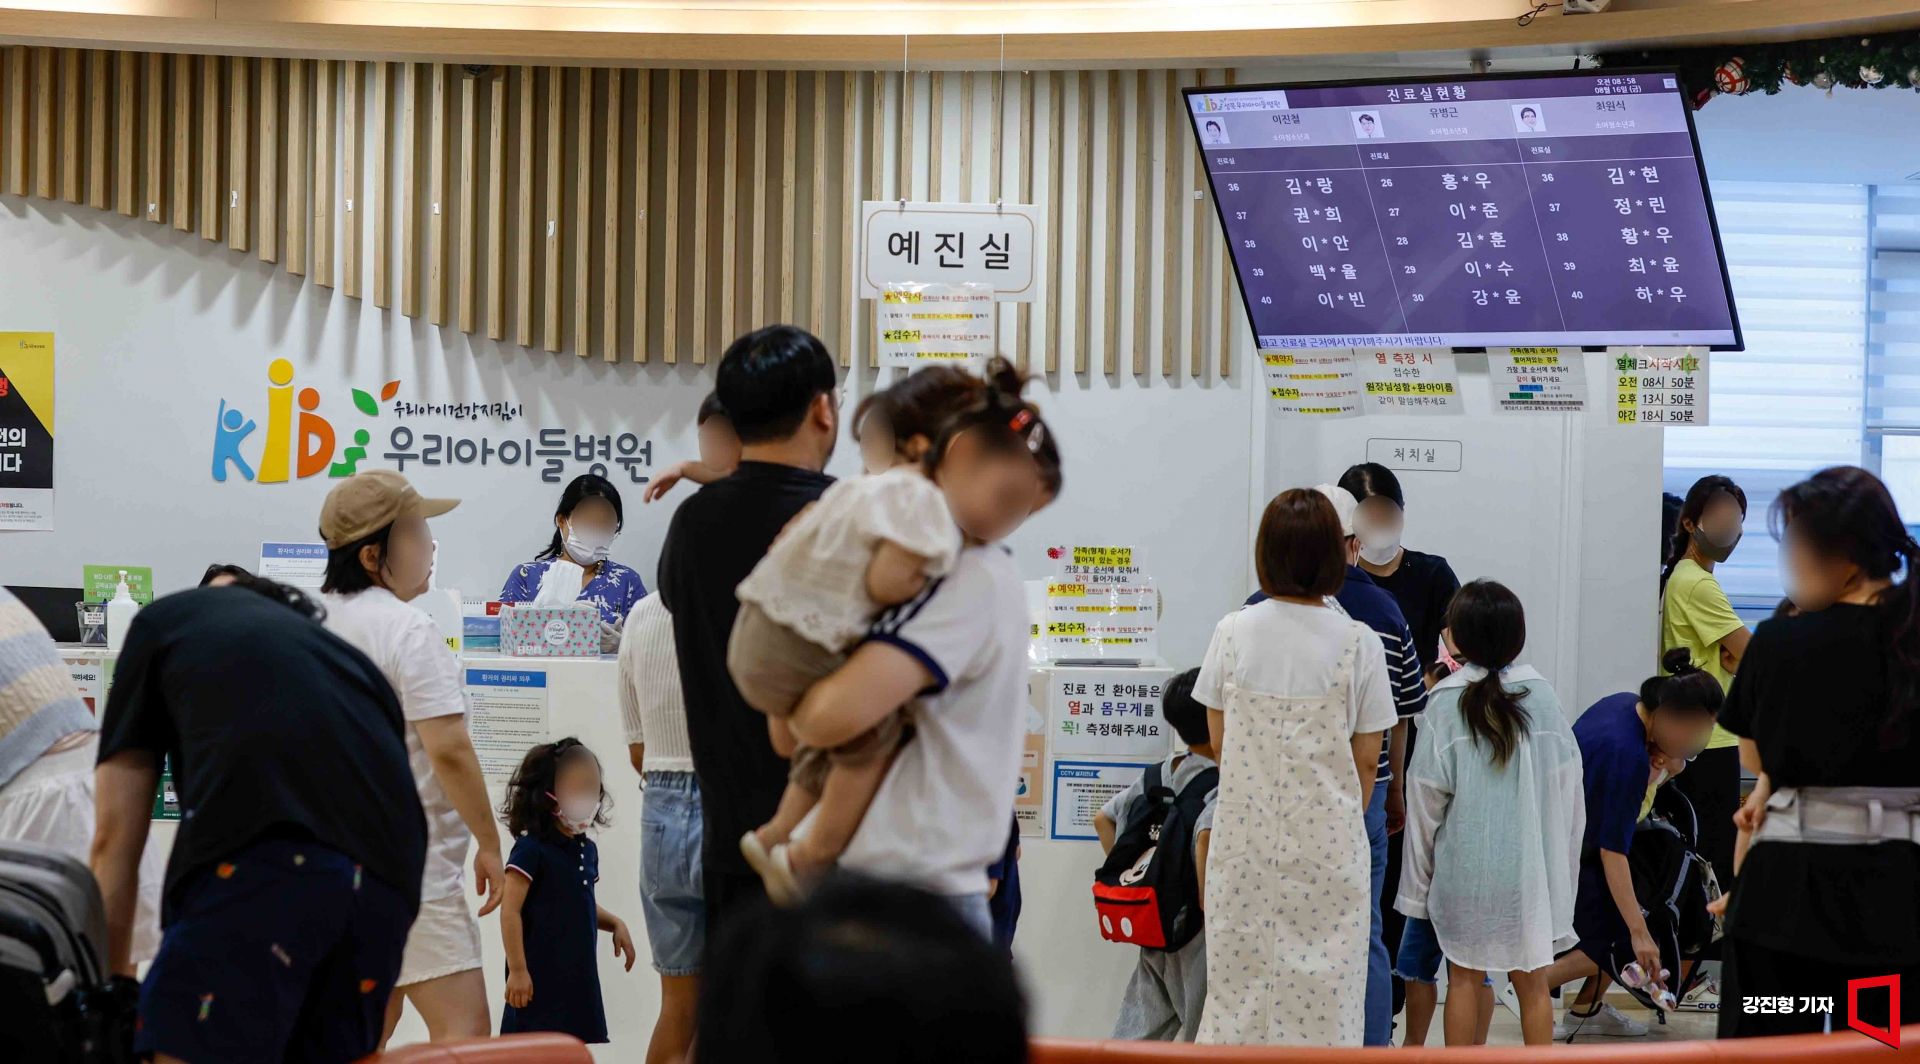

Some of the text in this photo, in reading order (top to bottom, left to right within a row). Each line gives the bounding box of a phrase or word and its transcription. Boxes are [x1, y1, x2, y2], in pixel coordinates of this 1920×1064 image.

[1597, 78, 1611, 86] 오전
[1594, 84, 1642, 94] 08월 16일 (금)
[1386, 86, 1467, 103] 진료실현황
[1596, 100, 1626, 111] 최원식
[1429, 107, 1459, 118] 유병근
[1272, 113, 1301, 125] 이진철
[1541, 173, 1554, 182] 36
[1227, 183, 1240, 192] 36
[1380, 179, 1393, 187] 26
[1388, 208, 1400, 216] 27
[1548, 203, 1561, 212] 37
[1236, 211, 1247, 220] 37
[1396, 237, 1408, 246] 28
[1556, 233, 1569, 241] 38
[1244, 239, 1256, 248] 38
[888, 231, 1009, 269] 예진실
[1404, 265, 1416, 274] 29
[1563, 262, 1576, 270] 39
[1252, 268, 1264, 276] 39
[1260, 296, 1272, 304] 40
[1412, 294, 1424, 302] 30
[1571, 291, 1583, 299] 40
[893, 330, 921, 340] 접수자
[1280, 338, 1307, 347] 진료실
[1310, 337, 1346, 347] 근처에서
[1348, 336, 1403, 346] 대기해주시기
[1405, 335, 1446, 346] 바랍니다.
[1375, 352, 1433, 365] 열 측정 시
[1617, 358, 1698, 371] 열체크시작시간
[1393, 367, 1421, 378] 접수한
[1366, 382, 1453, 393] 원장님성함+환아이름
[1618, 377, 1694, 388] 오전 08시 50분
[1277, 388, 1299, 397] 접수자
[1378, 396, 1447, 406] 같이 말씀해주세요
[1618, 394, 1694, 405] 오후 13시 50분
[393, 400, 523, 421] 우리아이건강지킴이
[1618, 411, 1694, 422] 야간 18시 50분
[384, 426, 652, 483] 우리아이들병원
[1393, 447, 1435, 462] 처치실
[1073, 547, 1131, 555] 가족(형제) 순서가
[1117, 556, 1131, 564] 경우
[1065, 565, 1079, 573] 가장
[1093, 565, 1115, 574] 순서에
[1057, 584, 1086, 593] 예약자
[1057, 622, 1086, 632] 접수자
[1063, 683, 1161, 698] 진료 전 환아들은
[1068, 700, 1155, 717] 열과 몸무게를
[1062, 721, 1160, 737] 꼭! 측정해주세요
